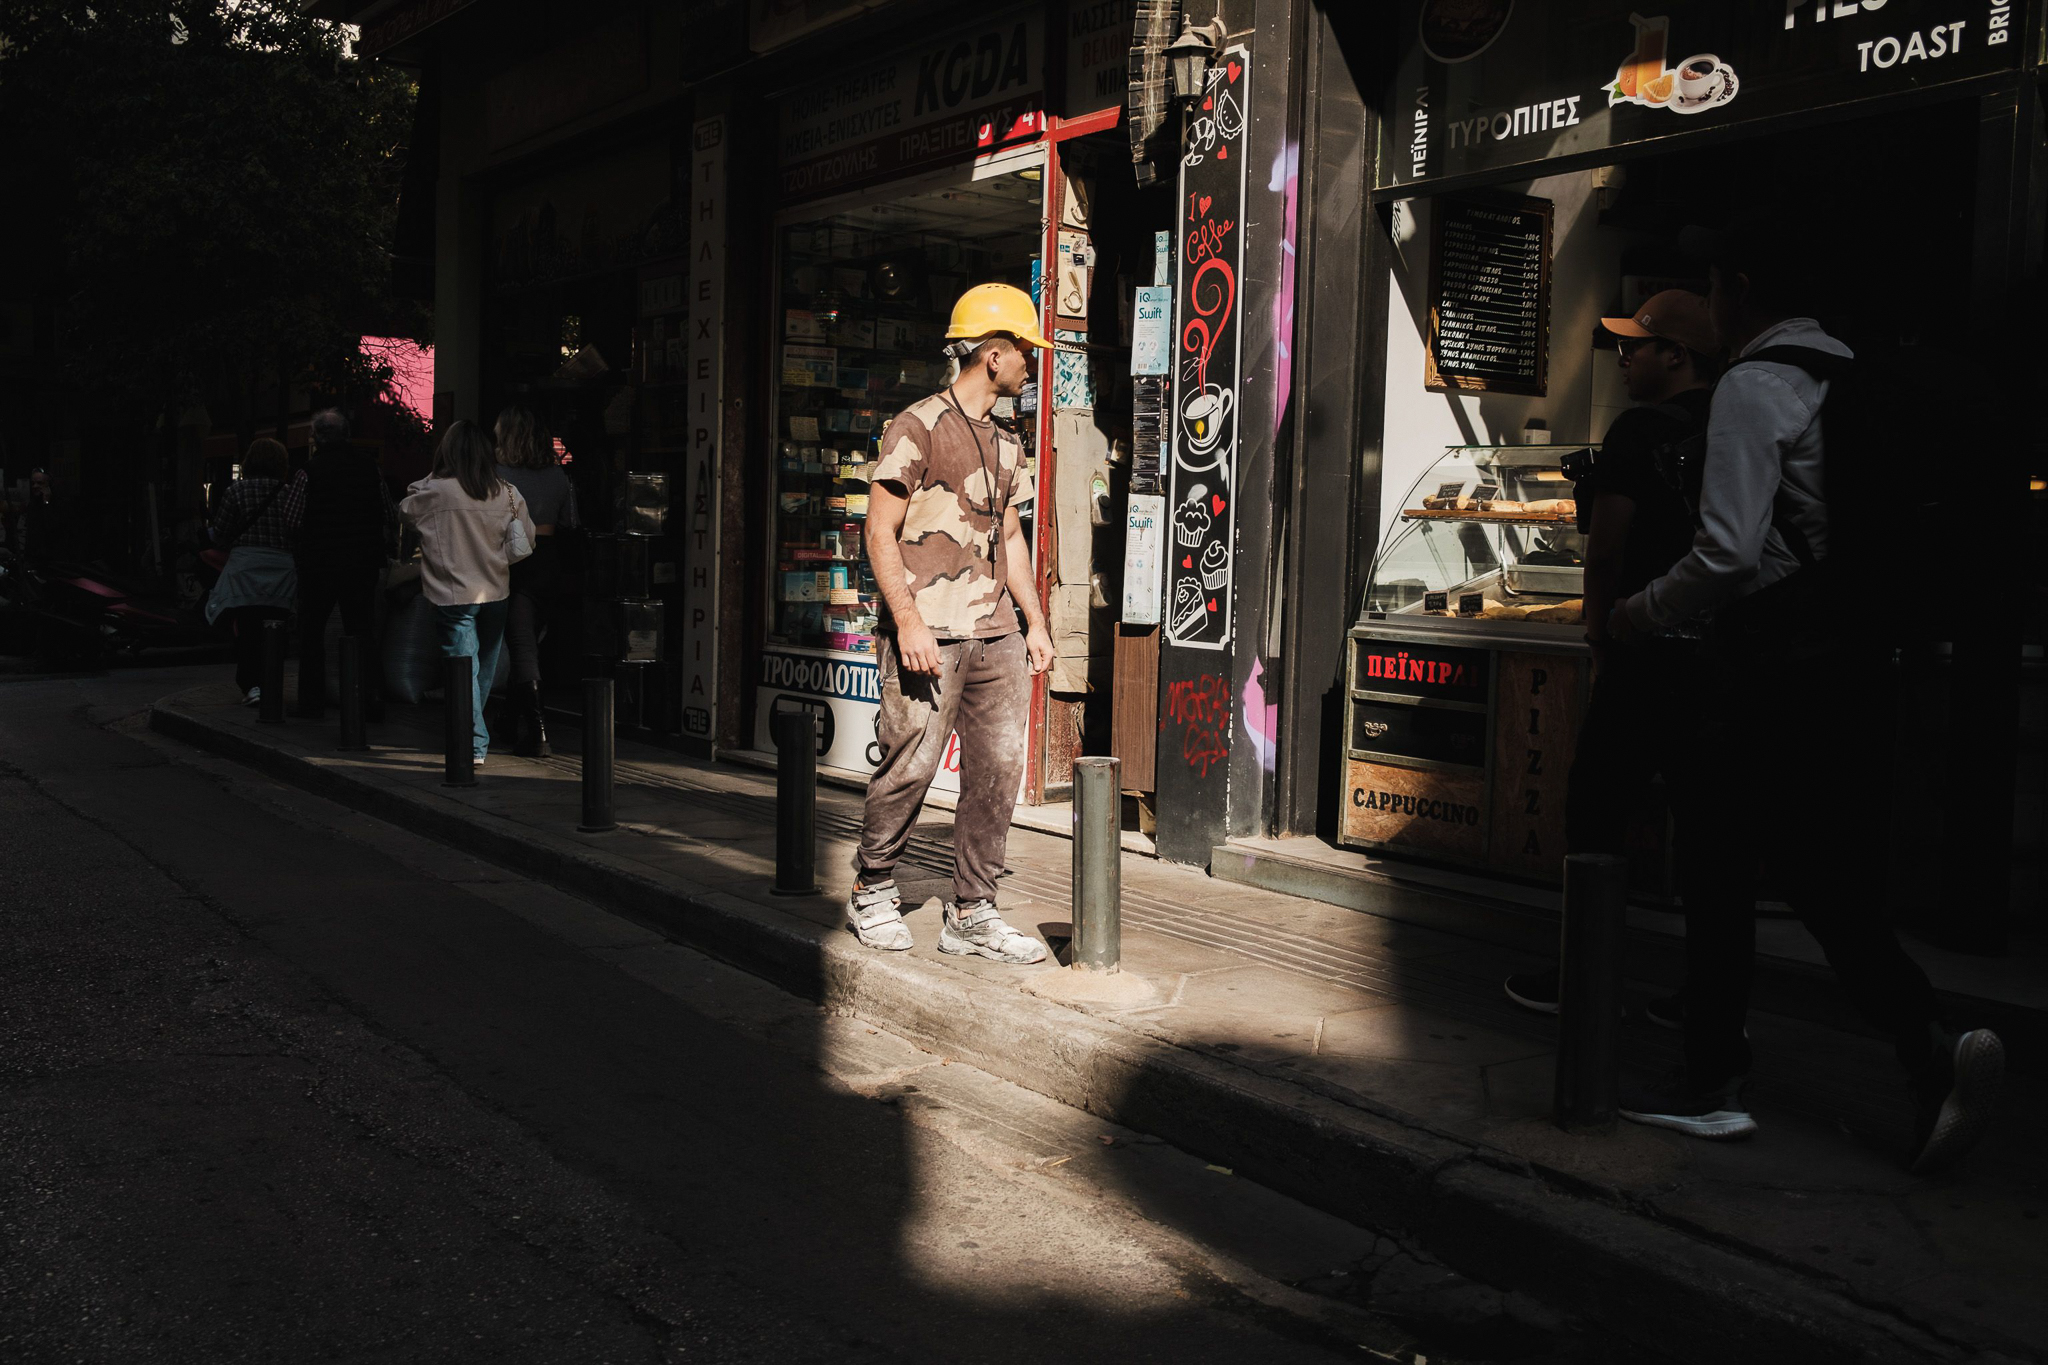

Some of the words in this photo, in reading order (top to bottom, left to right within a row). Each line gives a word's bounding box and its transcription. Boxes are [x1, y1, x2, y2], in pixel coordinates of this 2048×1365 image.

[1857, 20, 1967, 73] TOAST
[791, 65, 897, 123] HOME-THEATER
[1448, 95, 1581, 149] ΤΥΡΟΠΙΤΕΣ
[786, 102, 901, 158] ΗΧΕΙΑ-ΕΝΙΣΧΥΤΕΣ
[900, 106, 1013, 161] ΠΡΑΞΙΤΕΛΟΥΣ
[1022, 101, 1035, 127] 4
[782, 146, 879, 194] ΤΖΟΥΤΖΟΥΛΗΣ
[1187, 218, 1235, 265] Coffee
[1445, 231, 1476, 241] ESPRESSO
[1444, 241, 1475, 251] ESPRESSO
[1444, 251, 1479, 261] CAPPUCCINO
[1443, 261, 1478, 271] CAPPUCCINO
[1443, 271, 1466, 279] FREDDO
[1468, 274, 1499, 284] ESPRESSO
[1442, 281, 1465, 289] FREDDO
[1467, 283, 1502, 294] CAPPUCCINO
[1139, 292, 1151, 303] iQ
[1442, 291, 1468, 299] NESCAFE
[1442, 300, 1459, 308] LATTE
[1138, 307, 1162, 319] Swift
[1441, 330, 1470, 340] ΣΟΚΟΛΑΤΑ
[1466, 343, 1485, 351] ΧΥΜΟΣ
[1440, 349, 1459, 358] ΧΥΜΟΣ
[1439, 360, 1459, 368] ΧΥΜΟΣ
[1130, 516, 1153, 530] Swift
[1522, 668, 1547, 856] PIZZA
[1353, 787, 1479, 827] CAPPUCCINO
